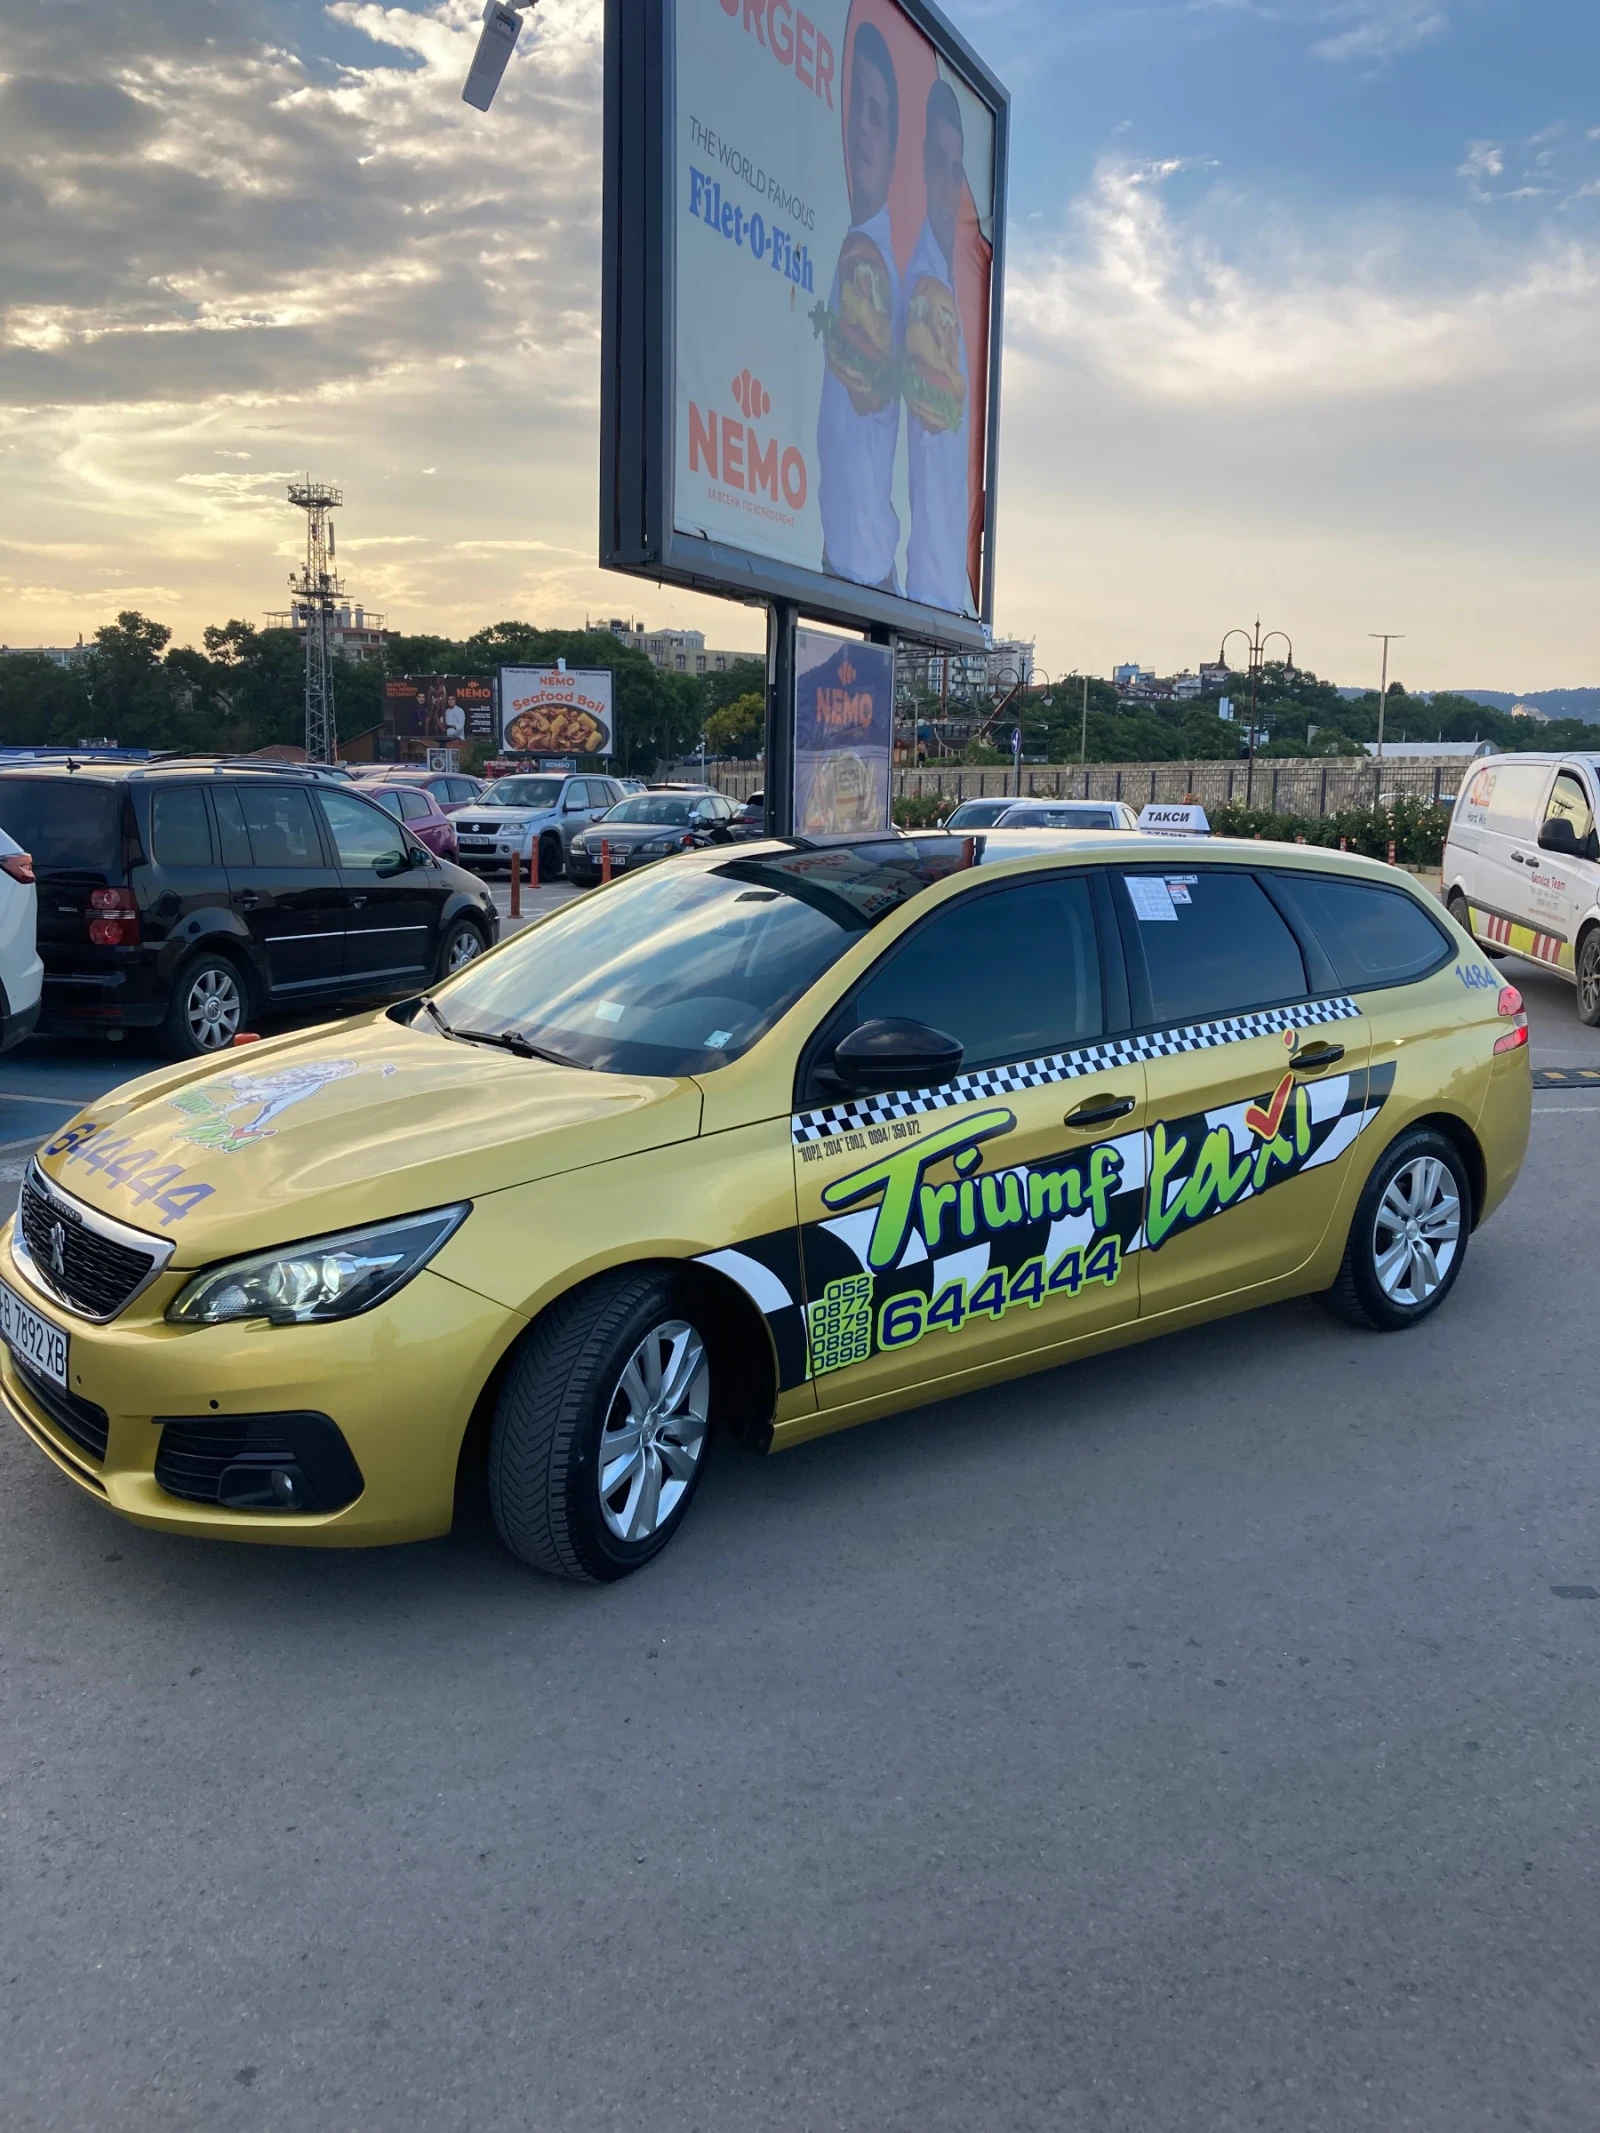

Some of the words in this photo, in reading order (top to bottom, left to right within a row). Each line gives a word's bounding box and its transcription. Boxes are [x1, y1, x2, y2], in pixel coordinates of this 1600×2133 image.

[689, 115, 716, 158] THE
[718, 137, 766, 194] WORLD
[768, 177, 816, 231] FAMOUS
[689, 165, 815, 293] Filet-O-Fish
[689, 400, 808, 511] NEMO
[456, 687, 492, 698] NEMO
[539, 676, 575, 686] NEMO
[512, 690, 574, 711] Seafood
[576, 694, 606, 714] Boil
[816, 686, 873, 728] NEMO
[1148, 811, 1190, 822] ТАКСИ
[1532, 871, 1550, 887] Service
[1552, 876, 1566, 891] Team
[1455, 964, 1499, 989] 1484
[821, 1107, 1125, 1270] Triumf
[1145, 1029, 1313, 1252] taxi
[846, 1132, 867, 1151] ЕООД
[892, 1122, 907, 1139] 350
[906, 1119, 922, 1136] 872
[43, 1122, 217, 1228] 644444
[827, 1276, 870, 1301] 052
[878, 1235, 1121, 1350] 644444
[813, 1292, 870, 1322] 0877
[813, 1310, 869, 1339] 0879
[15, 1303, 43, 1362] 7892
[46, 1329, 65, 1377] XB
[812, 1326, 868, 1355] 0882
[811, 1342, 867, 1371] 0898
